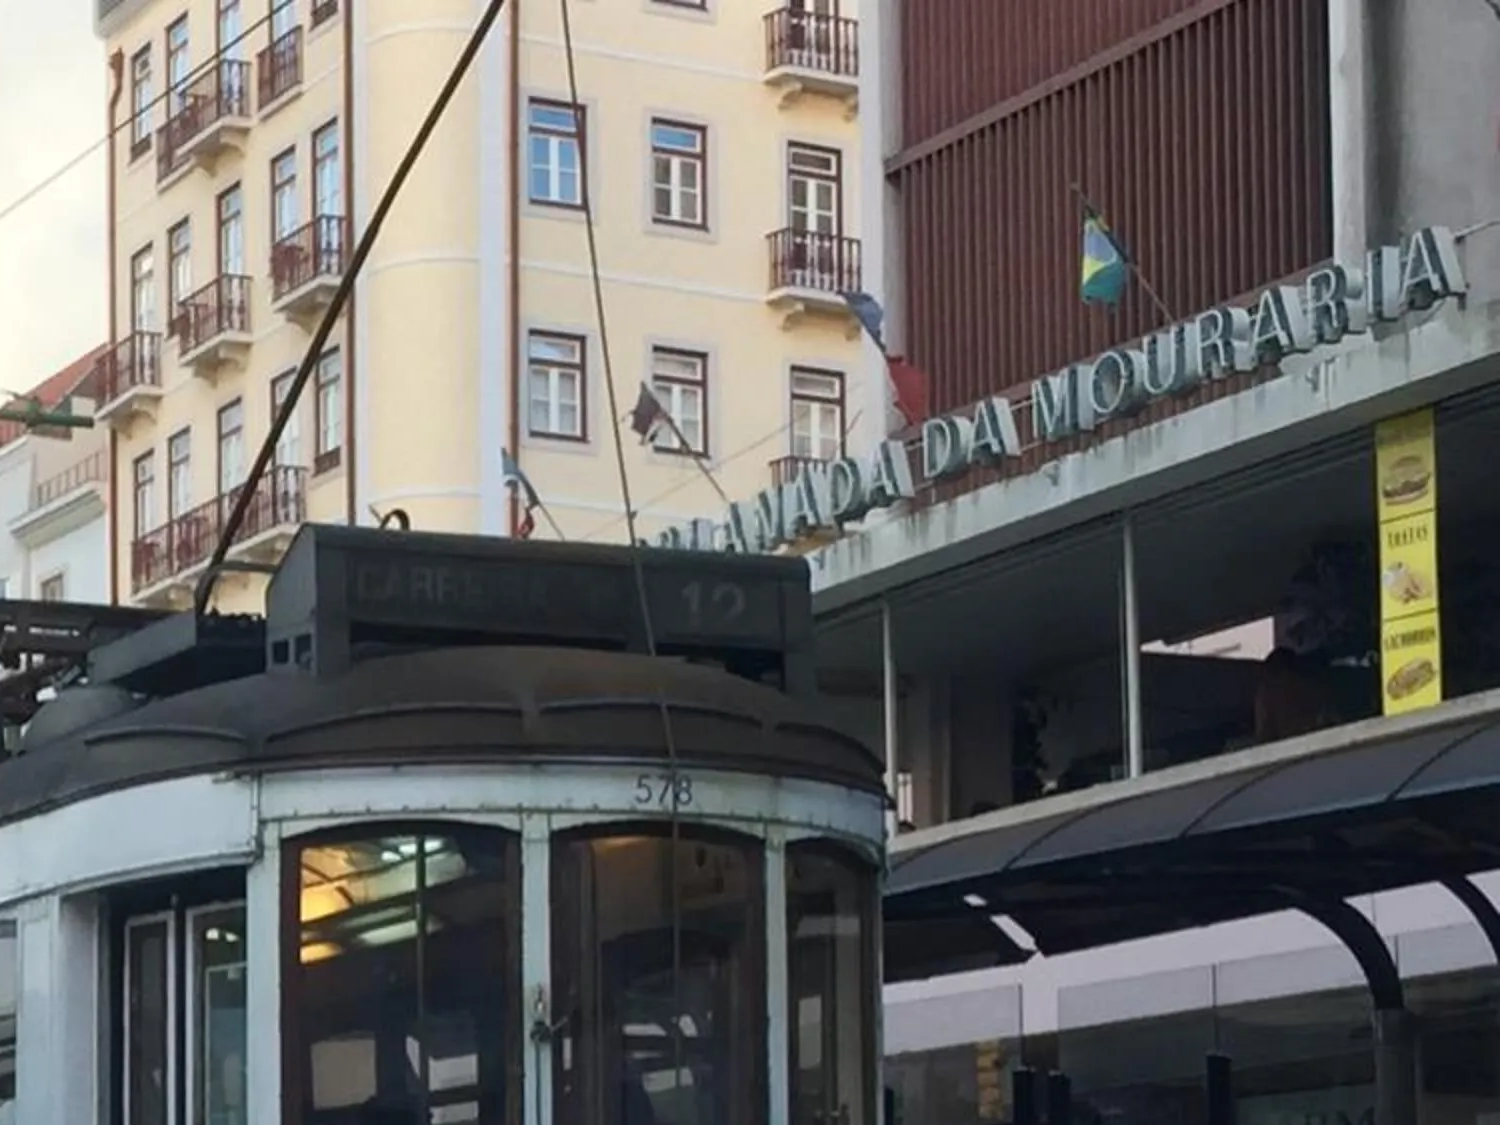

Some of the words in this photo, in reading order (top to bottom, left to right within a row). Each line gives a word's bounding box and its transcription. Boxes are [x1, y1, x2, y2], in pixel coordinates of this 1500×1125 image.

[921, 395, 1021, 482] DA
[1030, 226, 1466, 441] MOURARIA
[634, 775, 694, 804] 578
